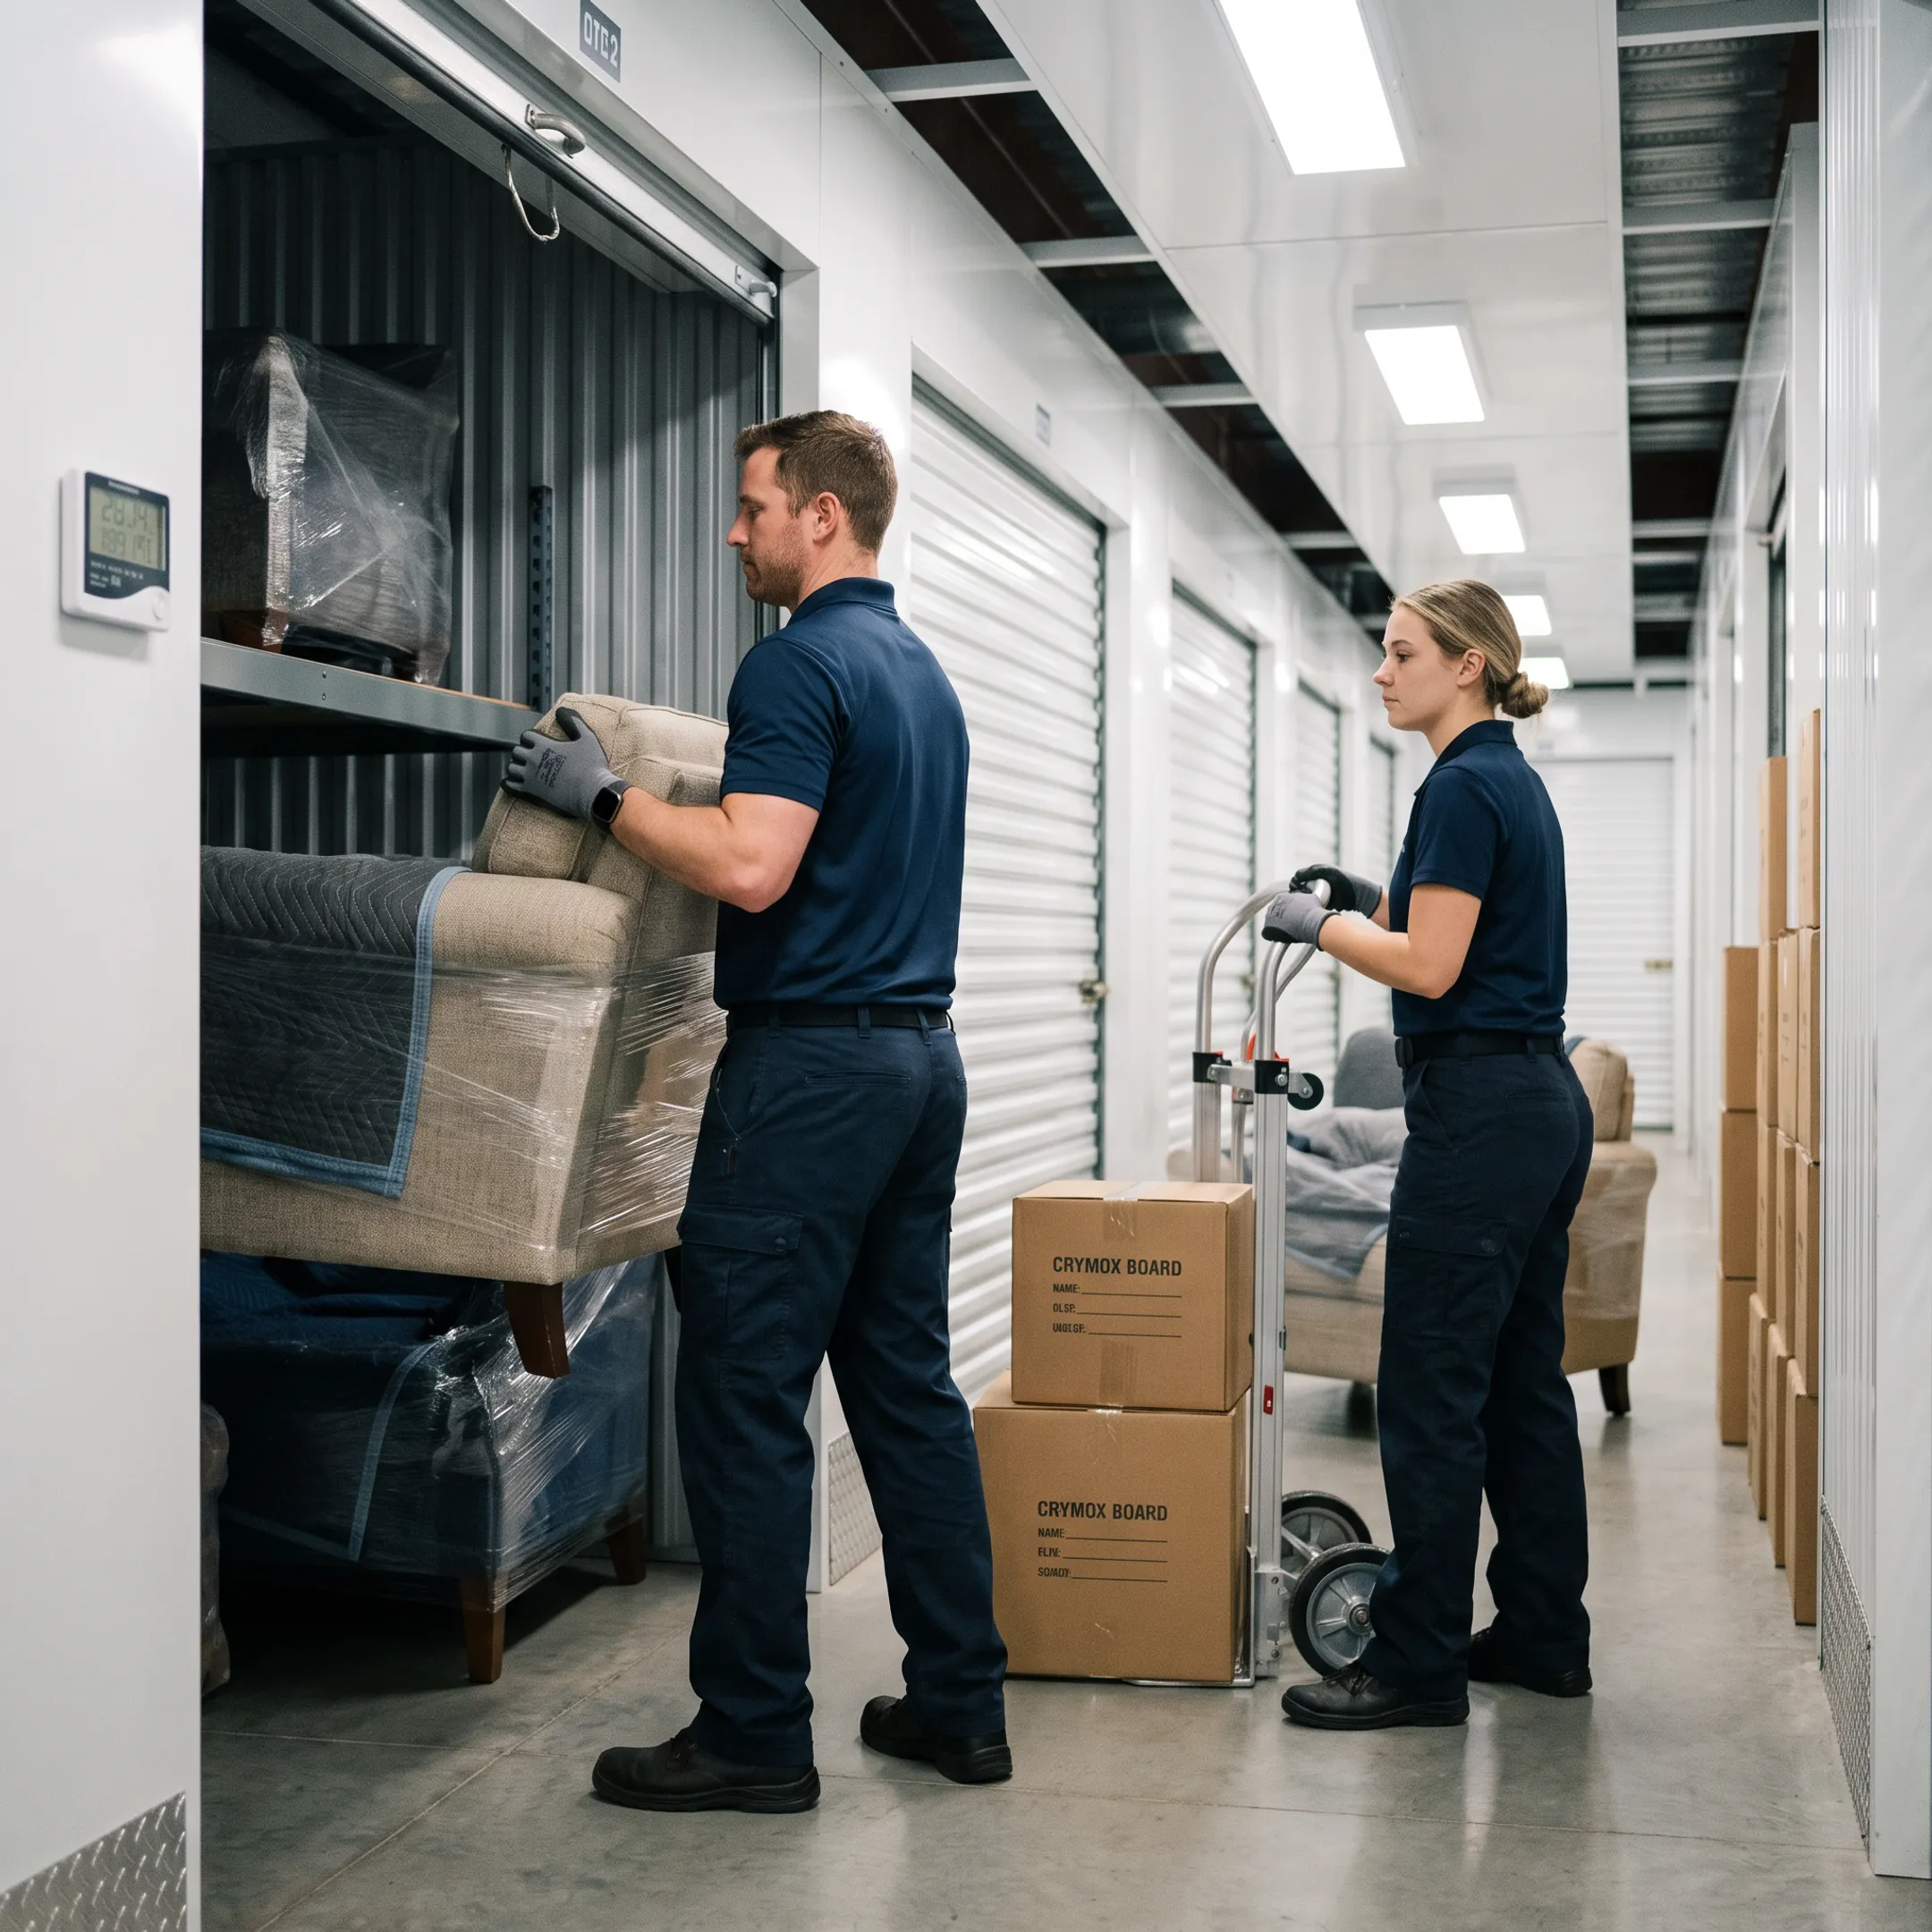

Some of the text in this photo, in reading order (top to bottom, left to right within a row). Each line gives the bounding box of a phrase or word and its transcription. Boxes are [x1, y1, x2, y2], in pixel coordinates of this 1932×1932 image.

[1053, 1257, 1182, 1275] CRYMOX BOARD
[1053, 1284, 1080, 1293] NAME:
[1038, 1501, 1167, 1521] CRYMOX BOARD
